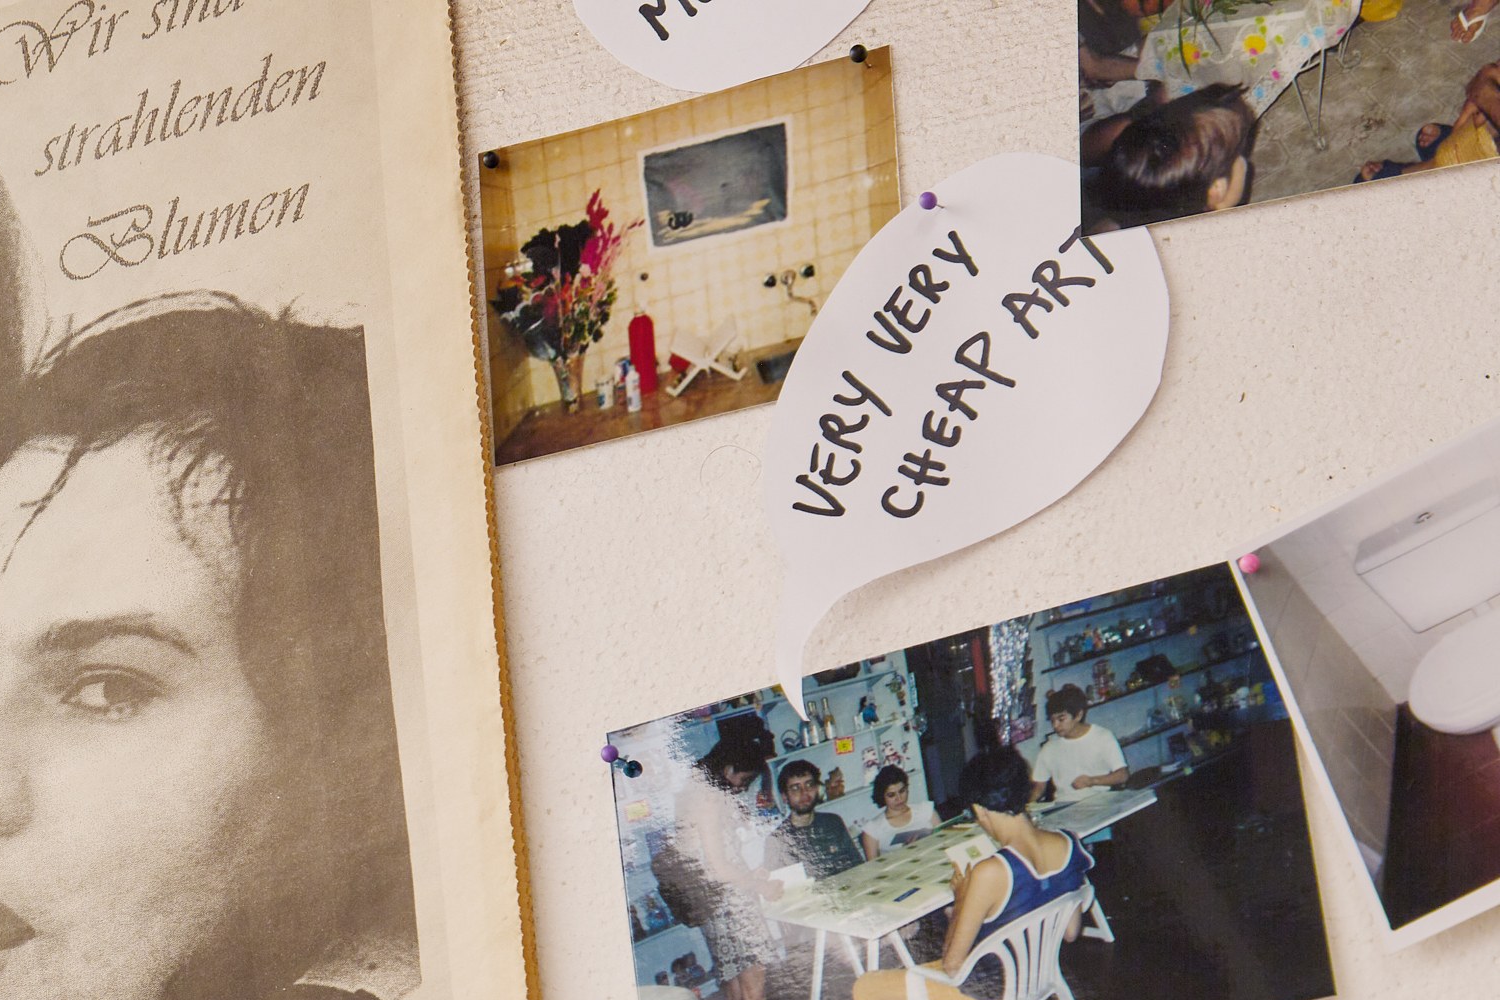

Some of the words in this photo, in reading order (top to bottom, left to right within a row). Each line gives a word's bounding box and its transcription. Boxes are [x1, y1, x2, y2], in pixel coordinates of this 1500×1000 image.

[141, 0, 244, 40] sin
[34, 53, 327, 177] strahlenden
[59, 181, 311, 281] Blumen
[793, 370, 892, 518] VERY
[866, 231, 978, 354] VERY
[881, 331, 1015, 518] CHEAP
[1002, 225, 1115, 339] ART
